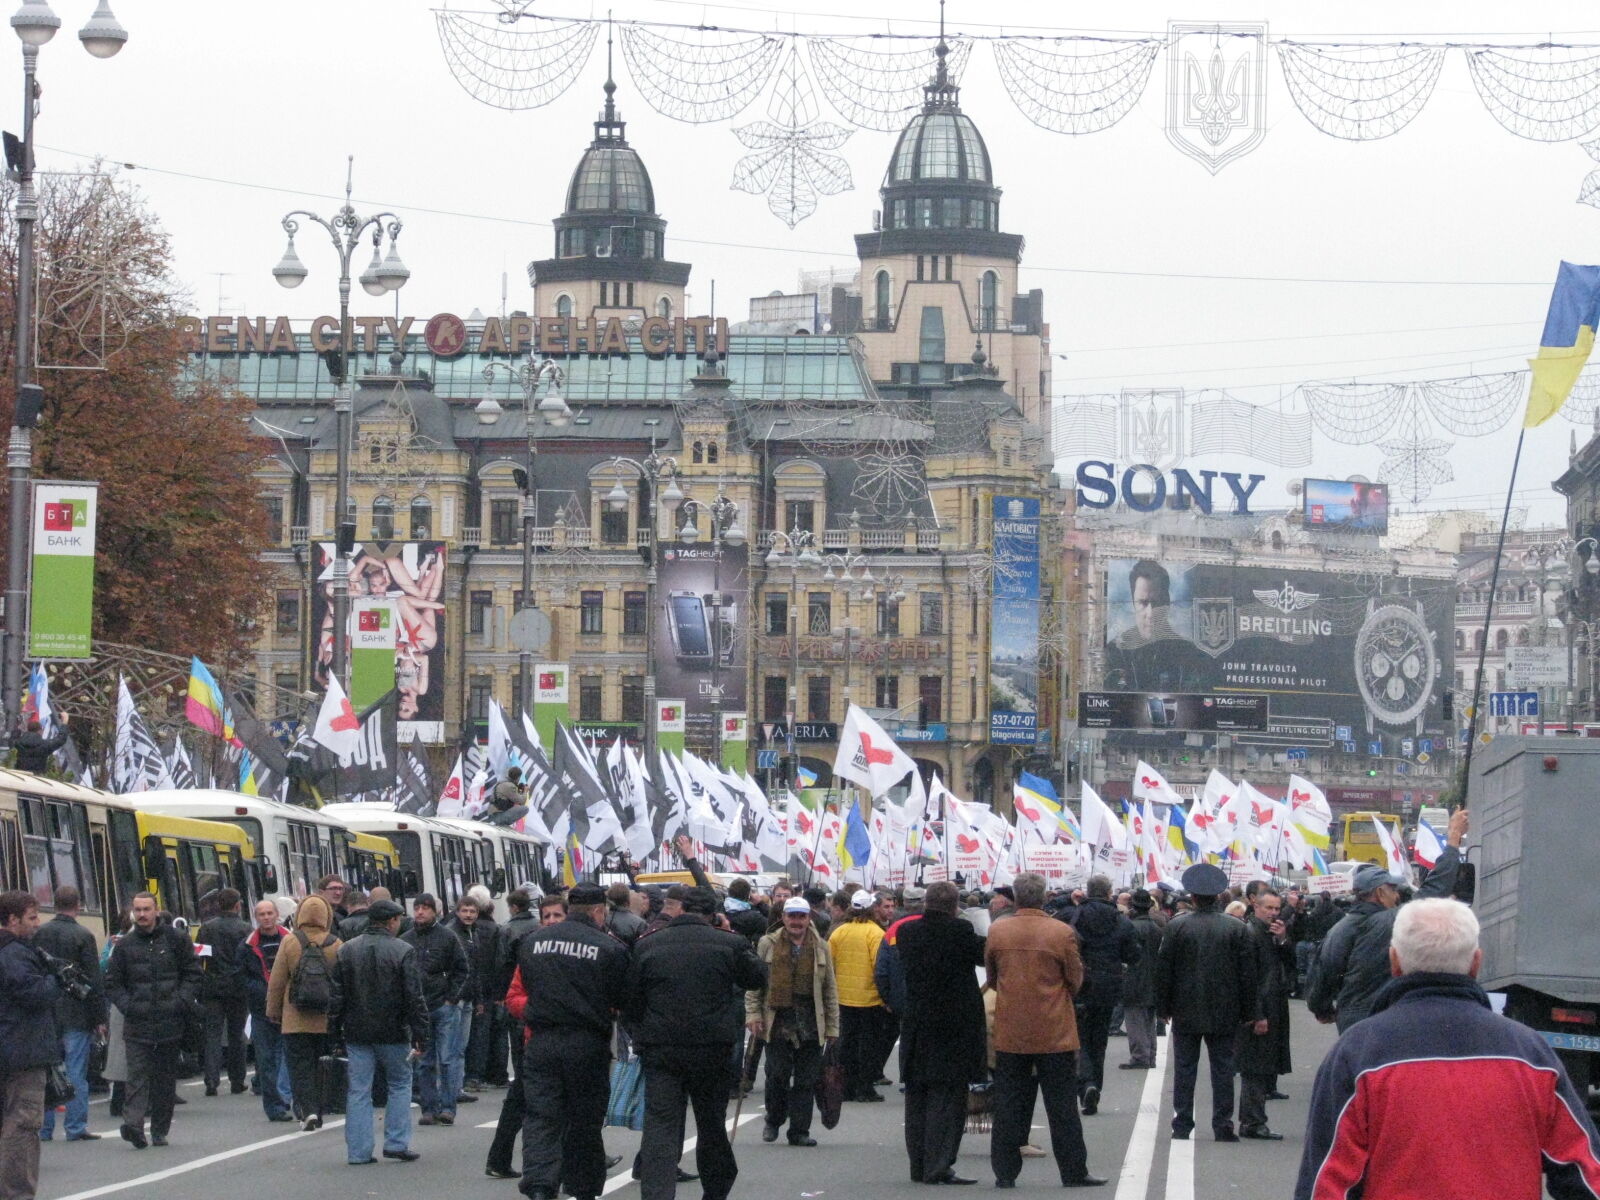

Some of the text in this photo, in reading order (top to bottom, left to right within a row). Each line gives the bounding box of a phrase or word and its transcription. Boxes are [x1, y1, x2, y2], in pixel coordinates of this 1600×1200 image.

[310, 315, 415, 352] CITY
[1076, 460, 1265, 516] SONY
[47, 509, 85, 521] БТА
[47, 535, 81, 547] БАНК
[1240, 616, 1332, 636] BREITLING
[1223, 662, 1297, 673] JOHN TRAVOLTA
[1226, 675, 1327, 687] PROFESSIONAL PILOT
[1087, 699, 1110, 708] LINK
[992, 715, 1035, 726] 537-07-07
[991, 730, 1034, 739] blagovist.ua
[533, 940, 600, 960] МІЛІЦІЯ
